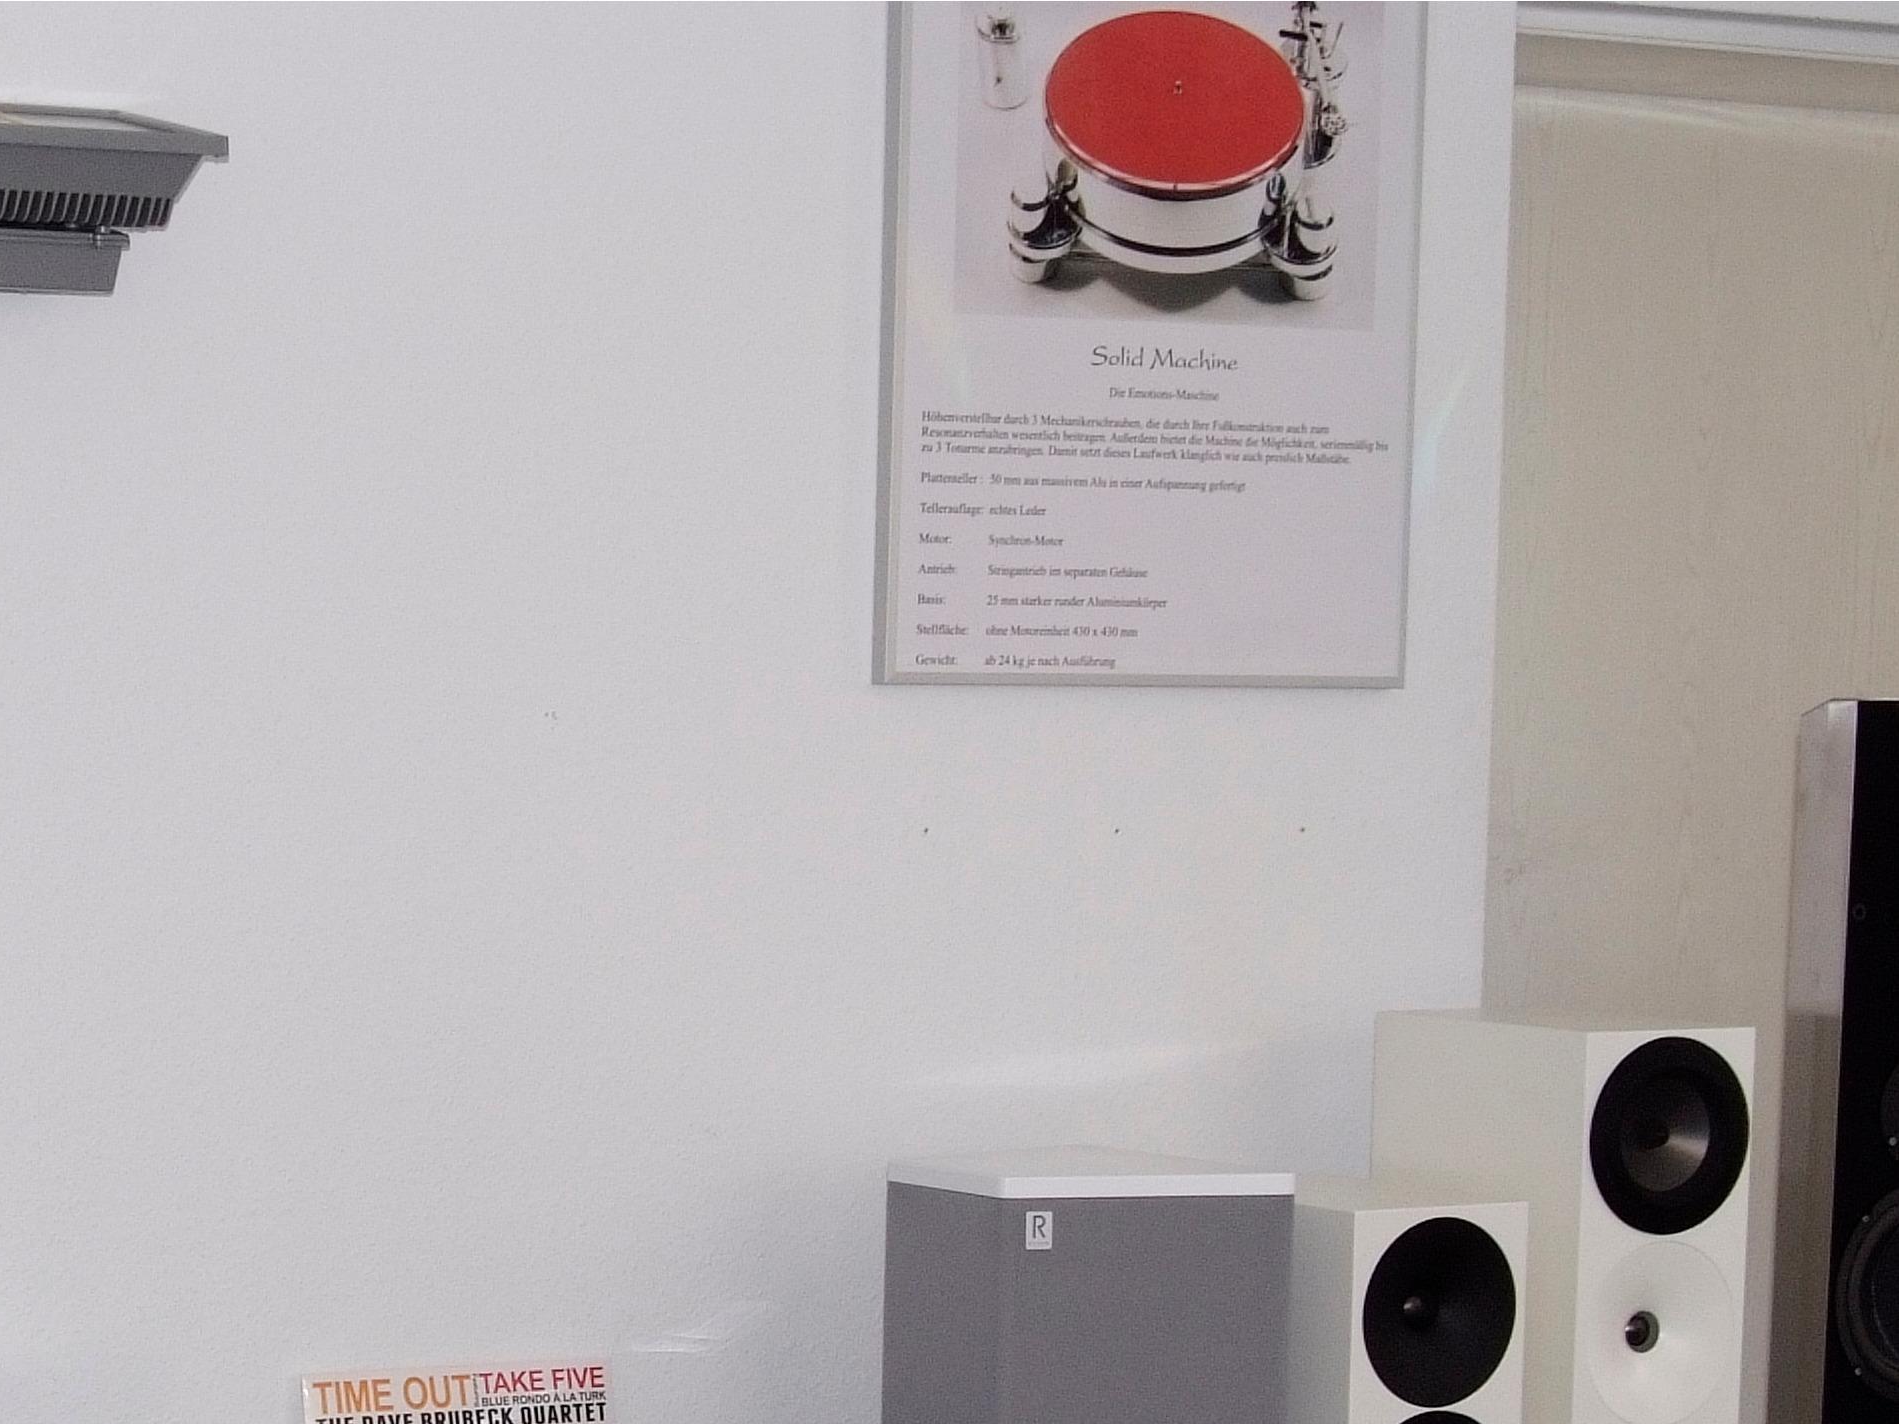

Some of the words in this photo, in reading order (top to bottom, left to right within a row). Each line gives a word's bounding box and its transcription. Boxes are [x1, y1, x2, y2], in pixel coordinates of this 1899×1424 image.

[1091, 345, 1144, 367] Solid
[1149, 348, 1238, 370] Machine
[1109, 387, 1127, 398] Die
[1019, 504, 1047, 516] Leder
[1032, 1214, 1047, 1239] R
[479, 1370, 546, 1395] TAKE
[551, 1366, 605, 1391] FIVE
[312, 1378, 395, 1415] TIME
[403, 1374, 471, 1411] OUT
[481, 1394, 511, 1407] BLUE
[512, 1391, 551, 1405] RONDO
[562, 1391, 577, 1403] LA
[578, 1390, 607, 1402] TURK
